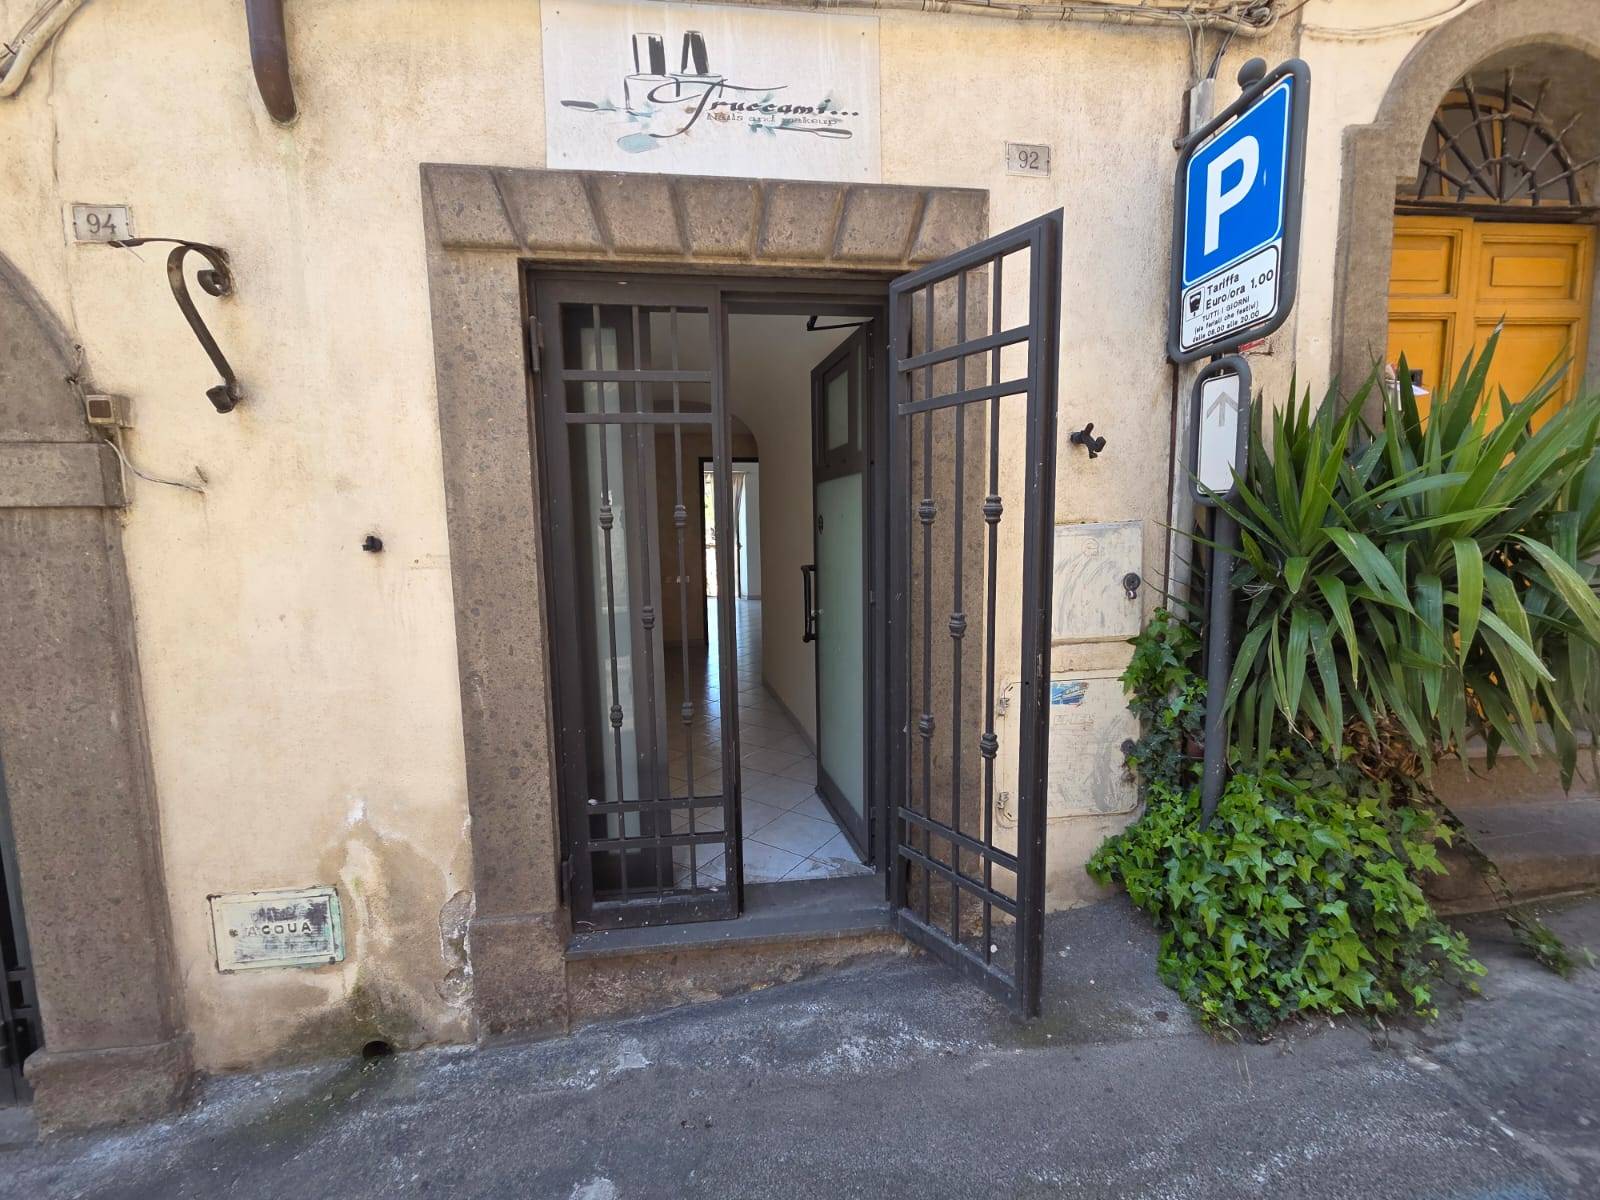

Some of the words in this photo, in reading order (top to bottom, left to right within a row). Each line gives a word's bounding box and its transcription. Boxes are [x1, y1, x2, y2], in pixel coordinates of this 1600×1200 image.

[1018, 150, 1040, 170] 92
[1203, 135, 1260, 256] P
[86, 213, 117, 234] 94
[1207, 273, 1240, 296] Tariffa
[1205, 284, 1246, 310] Euro/ora
[1202, 307, 1220, 322] TUTTI
[1226, 295, 1250, 312] GIORNI
[1224, 311, 1235, 321] che
[1226, 319, 1238, 329] alle
[1240, 310, 1260, 324] 20.00
